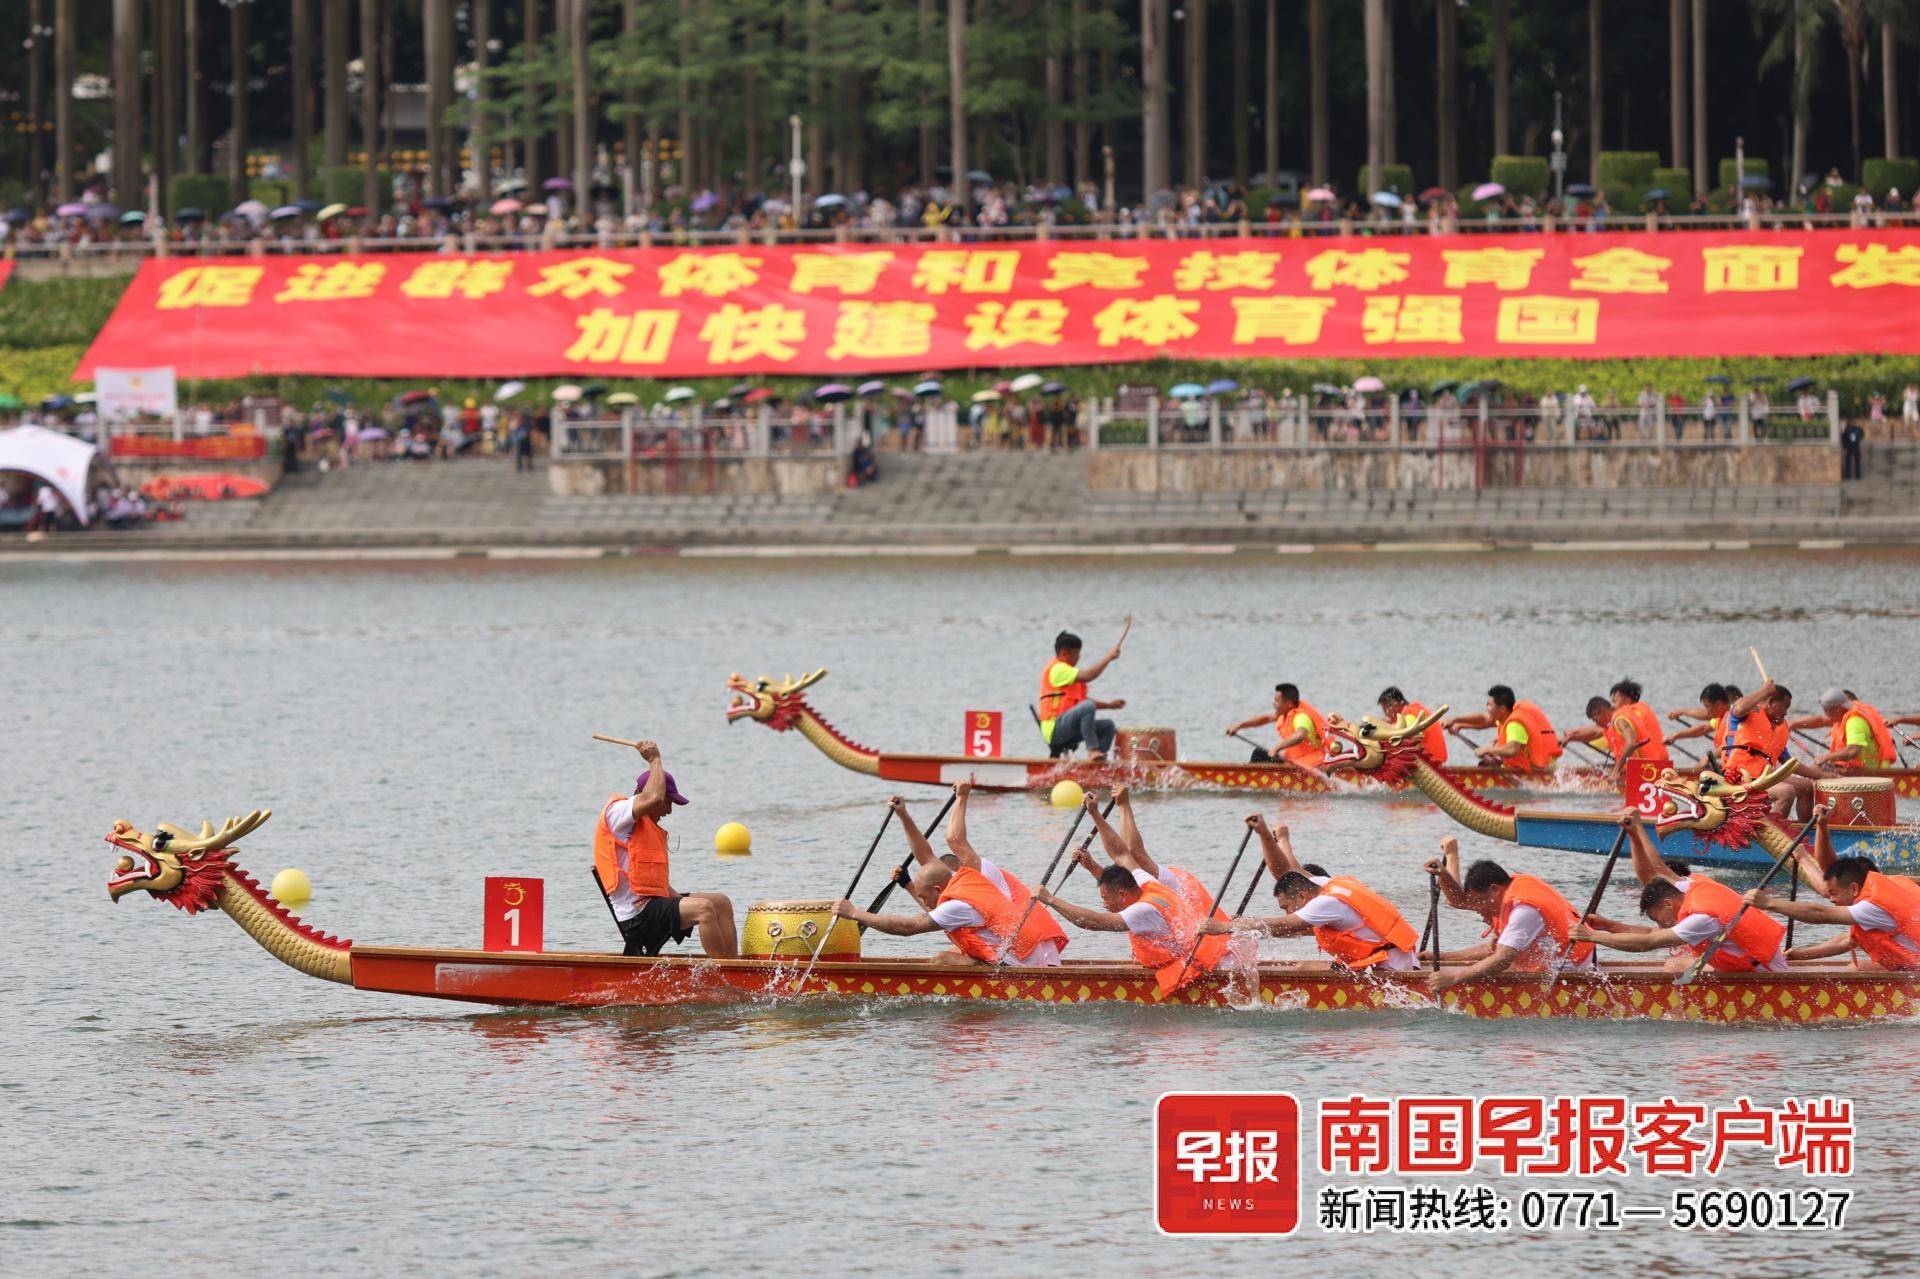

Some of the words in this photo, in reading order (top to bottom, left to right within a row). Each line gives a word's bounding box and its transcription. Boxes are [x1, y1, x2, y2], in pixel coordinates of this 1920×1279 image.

[564, 294, 1600, 365] 加快建设体育强国
[972, 729, 993, 758] 5
[1638, 782, 1657, 814] 3
[503, 908, 520, 947] 1
